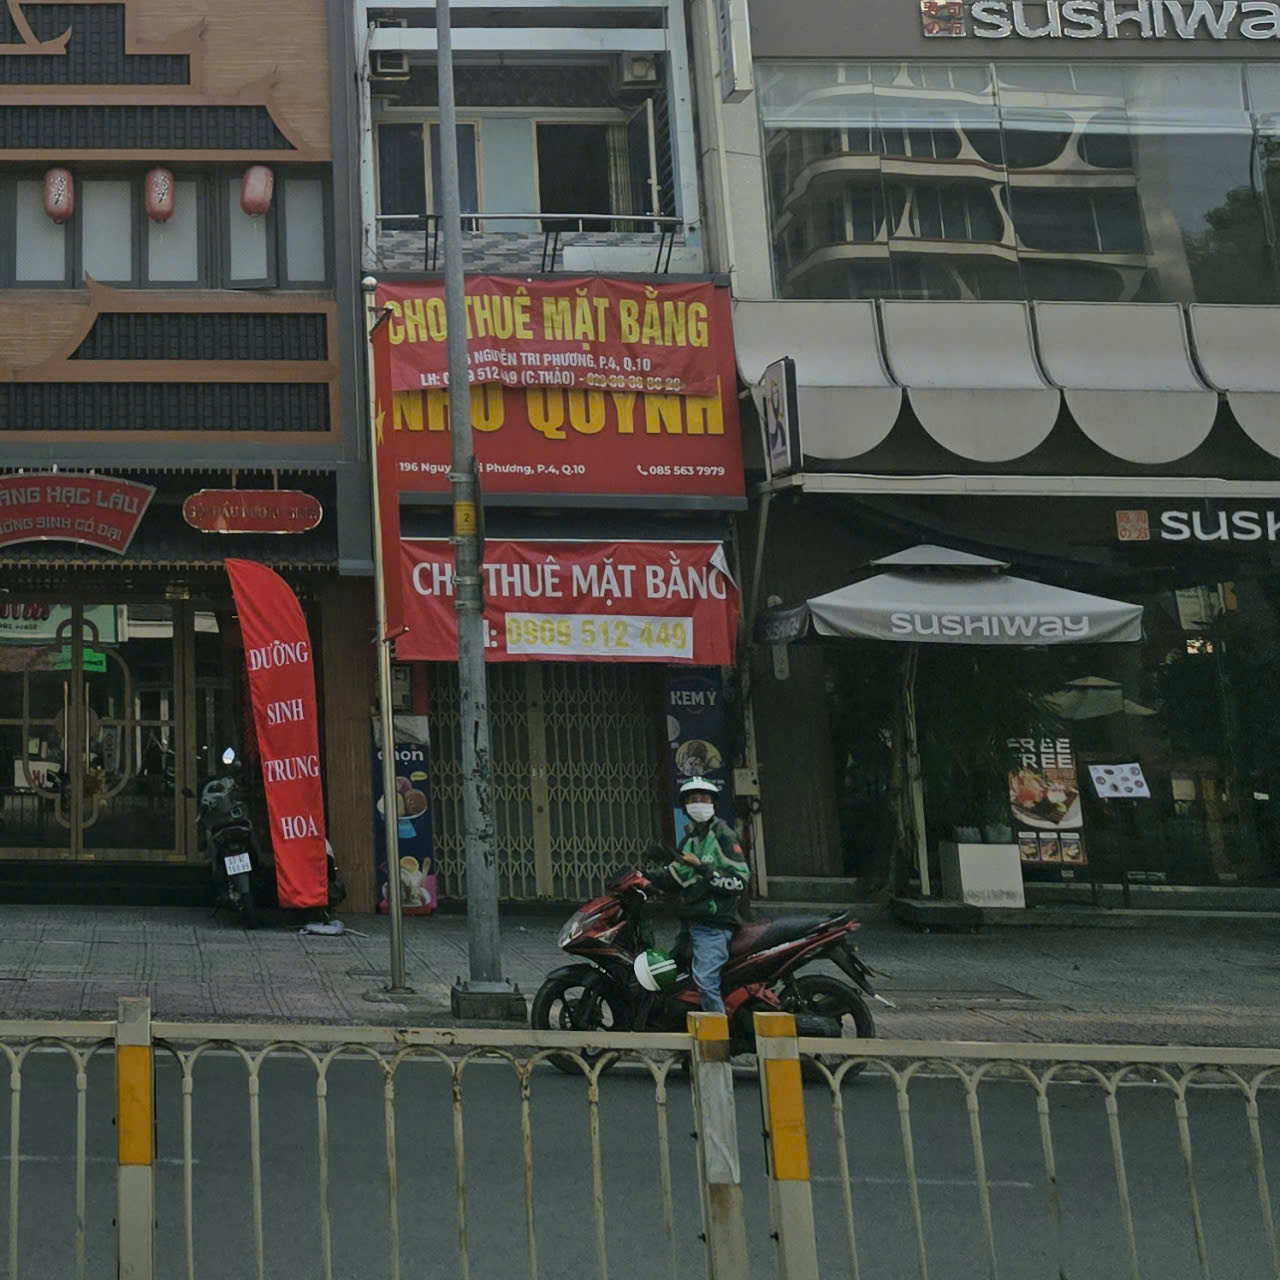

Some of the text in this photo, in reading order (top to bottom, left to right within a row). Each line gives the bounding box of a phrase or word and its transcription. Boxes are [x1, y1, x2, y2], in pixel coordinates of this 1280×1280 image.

[384, 285, 709, 351] CHO THUÊ MẶT BẰNG
[420, 372, 440, 386] LH:
[477, 366, 500, 381] 512
[623, 357, 651, 371] Q.10
[399, 462, 418, 472] 196
[561, 464, 586, 475] Q.10
[649, 465, 725, 476] 085 563 7979
[36, 516, 71, 529] SINH
[412, 550, 727, 606] CH THUÊ MẶT BẰNG
[508, 617, 570, 646] 0909
[581, 619, 629, 649] 512
[639, 621, 687, 650] 449
[249, 640, 309, 671] DƯỠNG
[267, 698, 305, 726] SINH
[264, 755, 319, 782] TRUNG
[1020, 753, 1073, 768] REE
[281, 815, 319, 841] HOA
